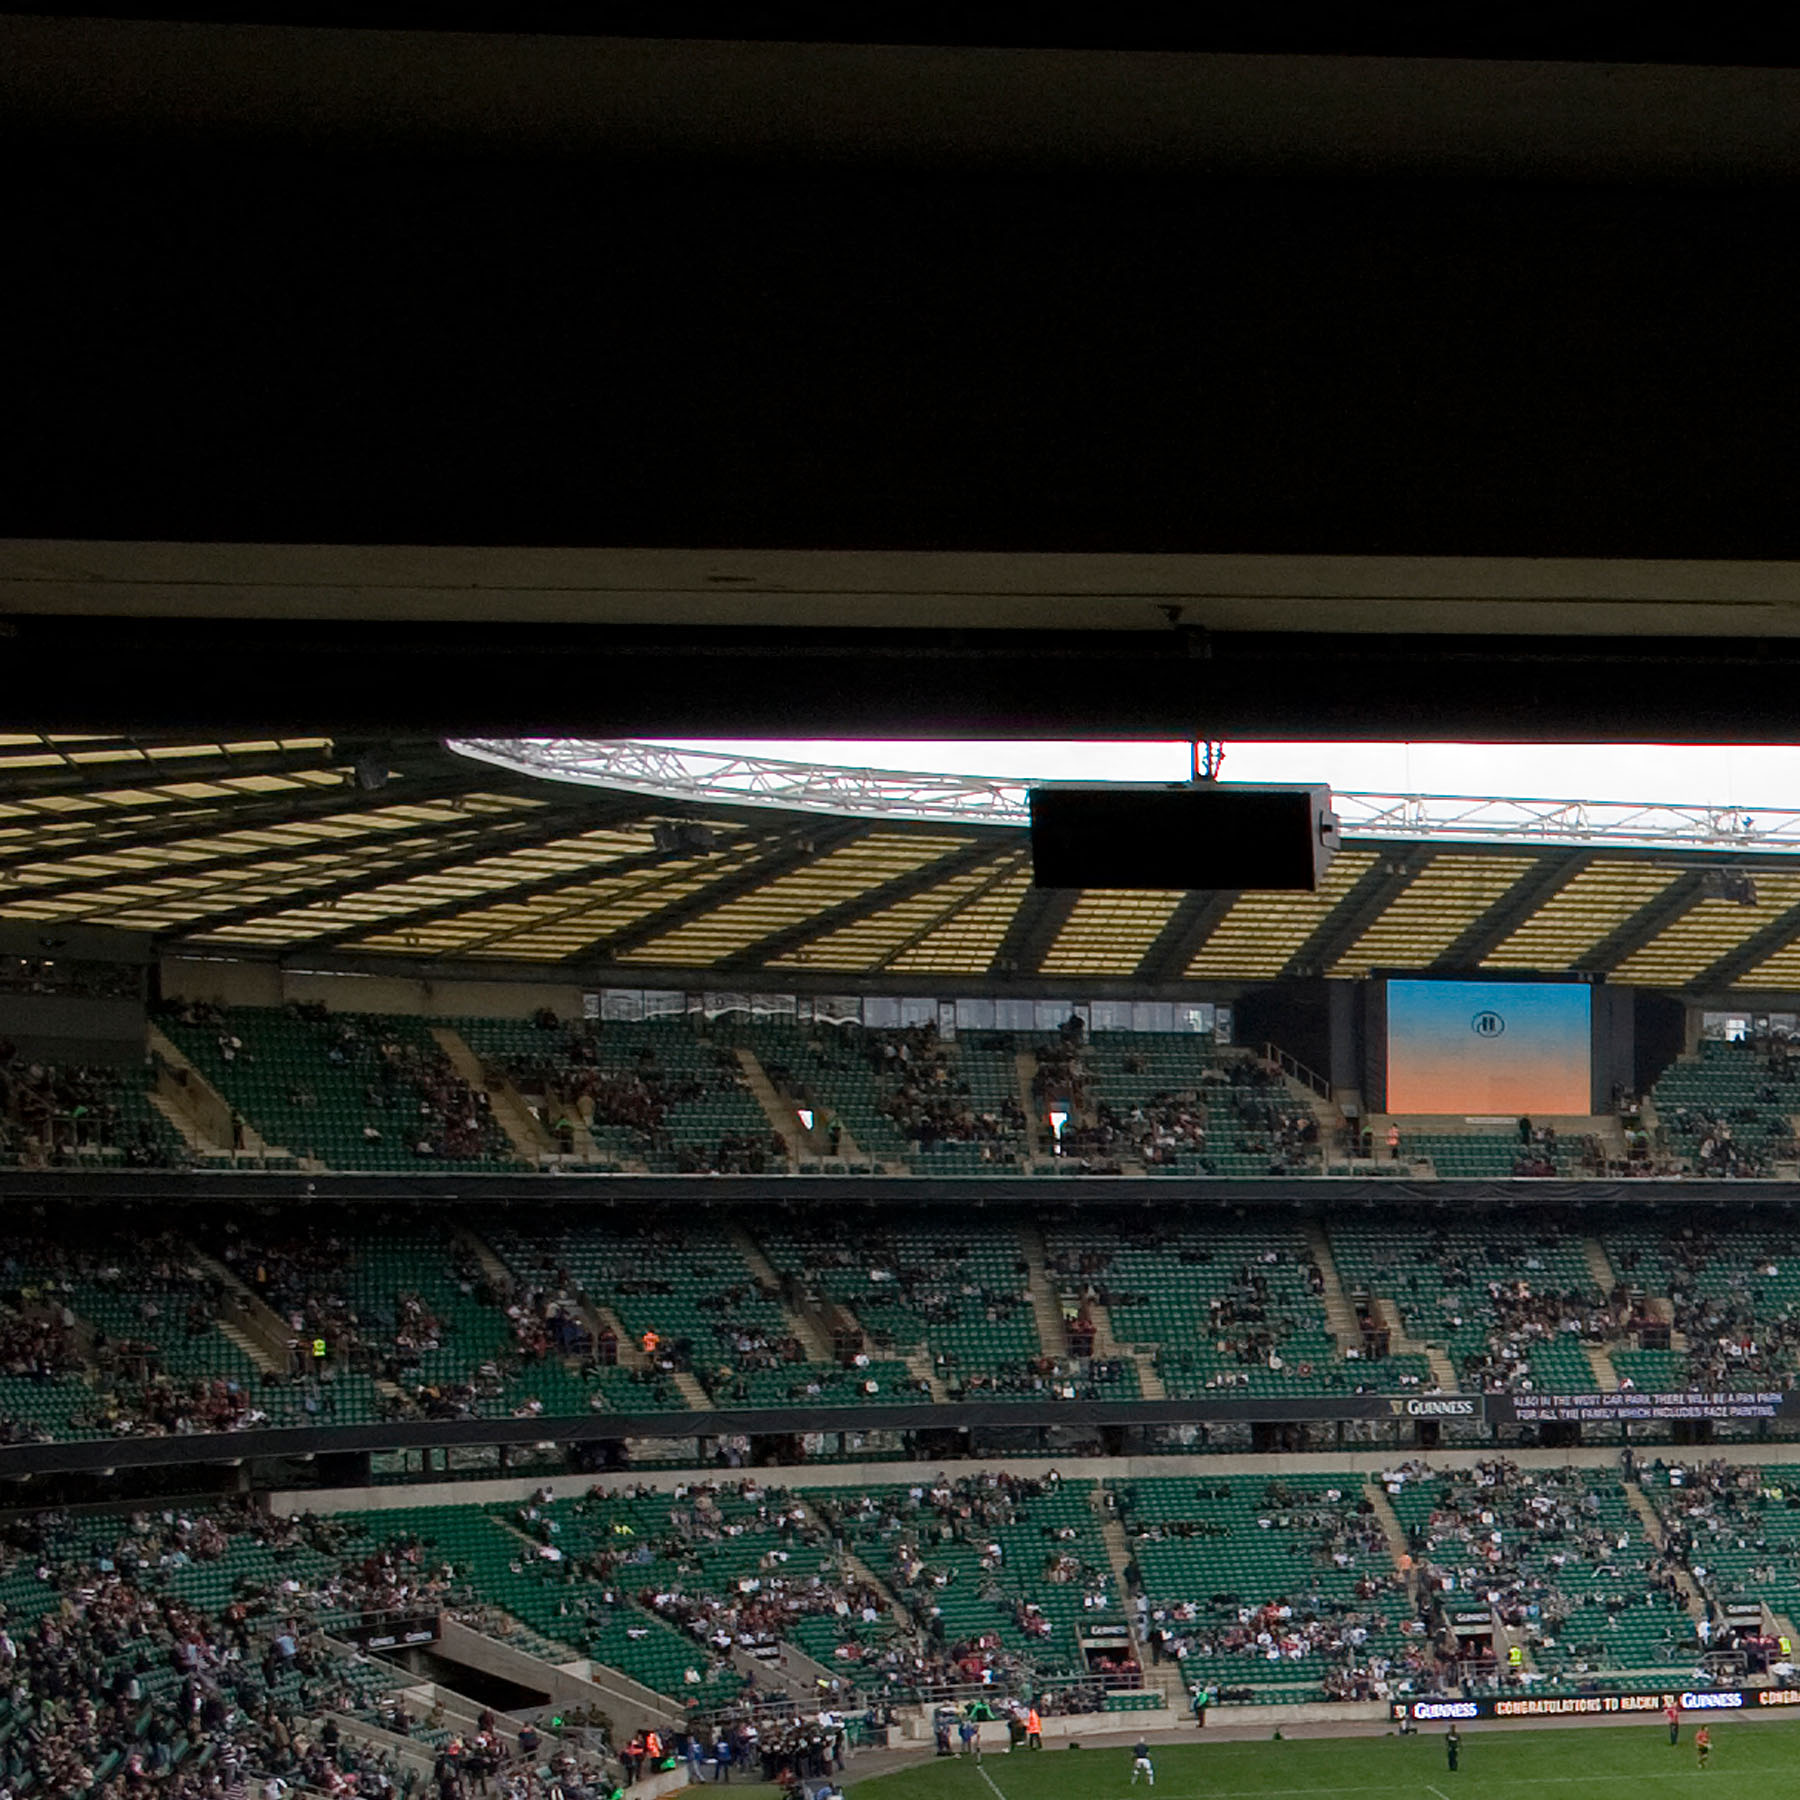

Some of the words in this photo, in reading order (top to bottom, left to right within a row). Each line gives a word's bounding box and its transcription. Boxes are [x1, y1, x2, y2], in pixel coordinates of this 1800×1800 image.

[1408, 1399, 1473, 1416] GUINNESS
[1603, 1697, 1619, 1710] TO
[1681, 1692, 1743, 1710] GUINNESS
[1414, 1701, 1479, 1719] GUINNESS
